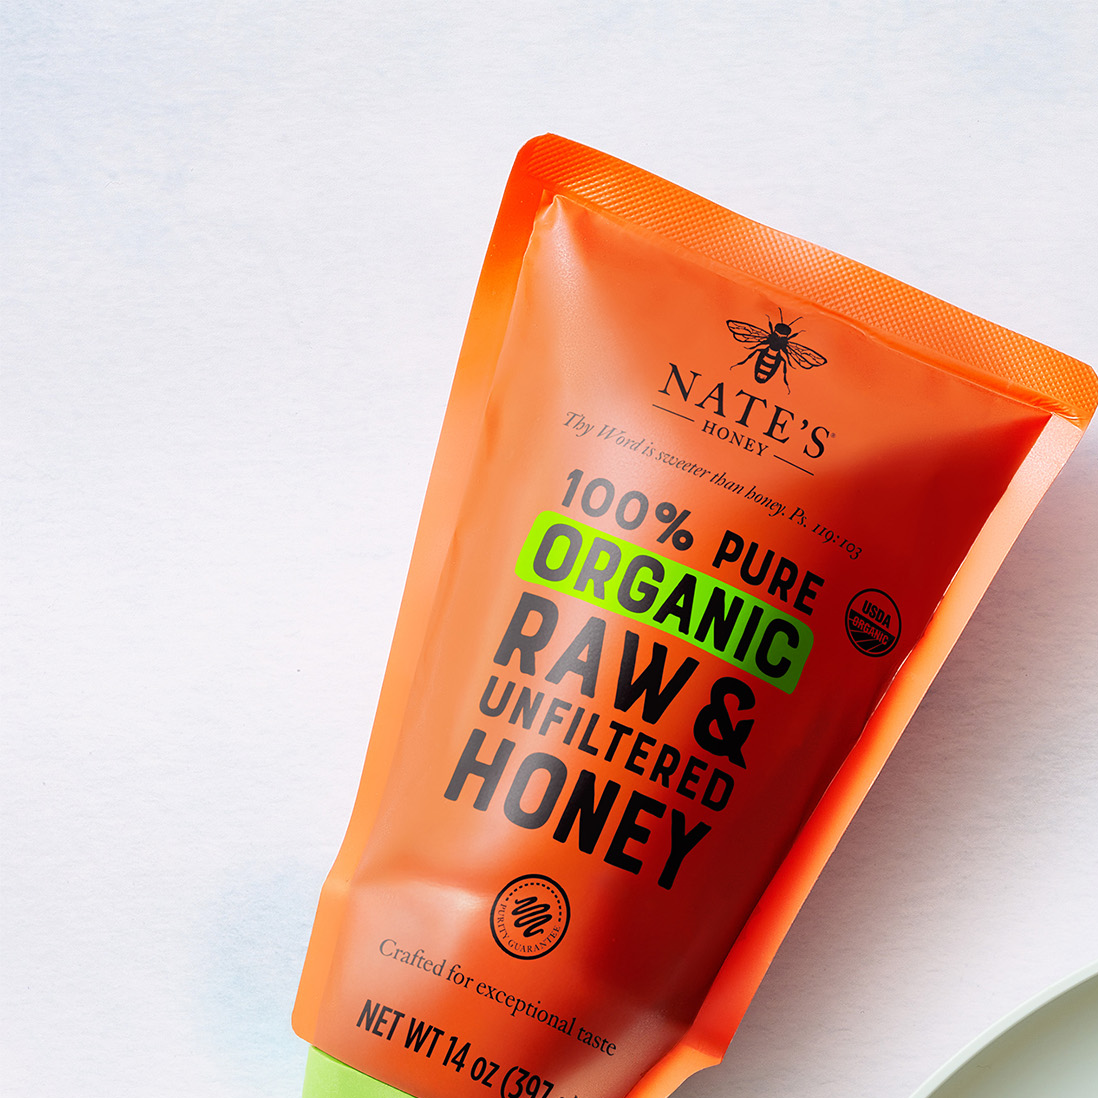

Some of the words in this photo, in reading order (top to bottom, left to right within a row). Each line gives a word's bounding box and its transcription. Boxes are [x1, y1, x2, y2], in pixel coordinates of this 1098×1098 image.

[658, 362, 830, 459] NATE'S
[701, 420, 769, 457] HONEY
[563, 411, 595, 437] Thy
[596, 424, 646, 451] Word
[641, 442, 656, 457] is
[655, 451, 711, 478] sweeter
[709, 472, 745, 494] than
[744, 485, 786, 517] honey.
[788, 507, 807, 528] Ps.
[533, 523, 800, 678] ORGANIC
[561, 468, 694, 551] 100%
[712, 530, 825, 616] PURE
[852, 616, 889, 646] ORGANIC
[862, 599, 891, 629] USDA
[493, 591, 700, 725] RAW
[693, 676, 756, 769] &
[479, 675, 735, 812] UNFILTERED
[443, 728, 712, 890] HONEY
[497, 903, 510, 940] PURITY
[507, 925, 561, 953] GUARANTEE
[356, 999, 405, 1041] NET
[404, 1017, 445, 1058] WT
[442, 1036, 471, 1072] 14
[470, 1056, 500, 1088] oz
[379, 938, 447, 977] Crafted
[446, 964, 474, 989] for
[476, 981, 577, 1036] exceptional
[576, 1026, 617, 1056] taste
